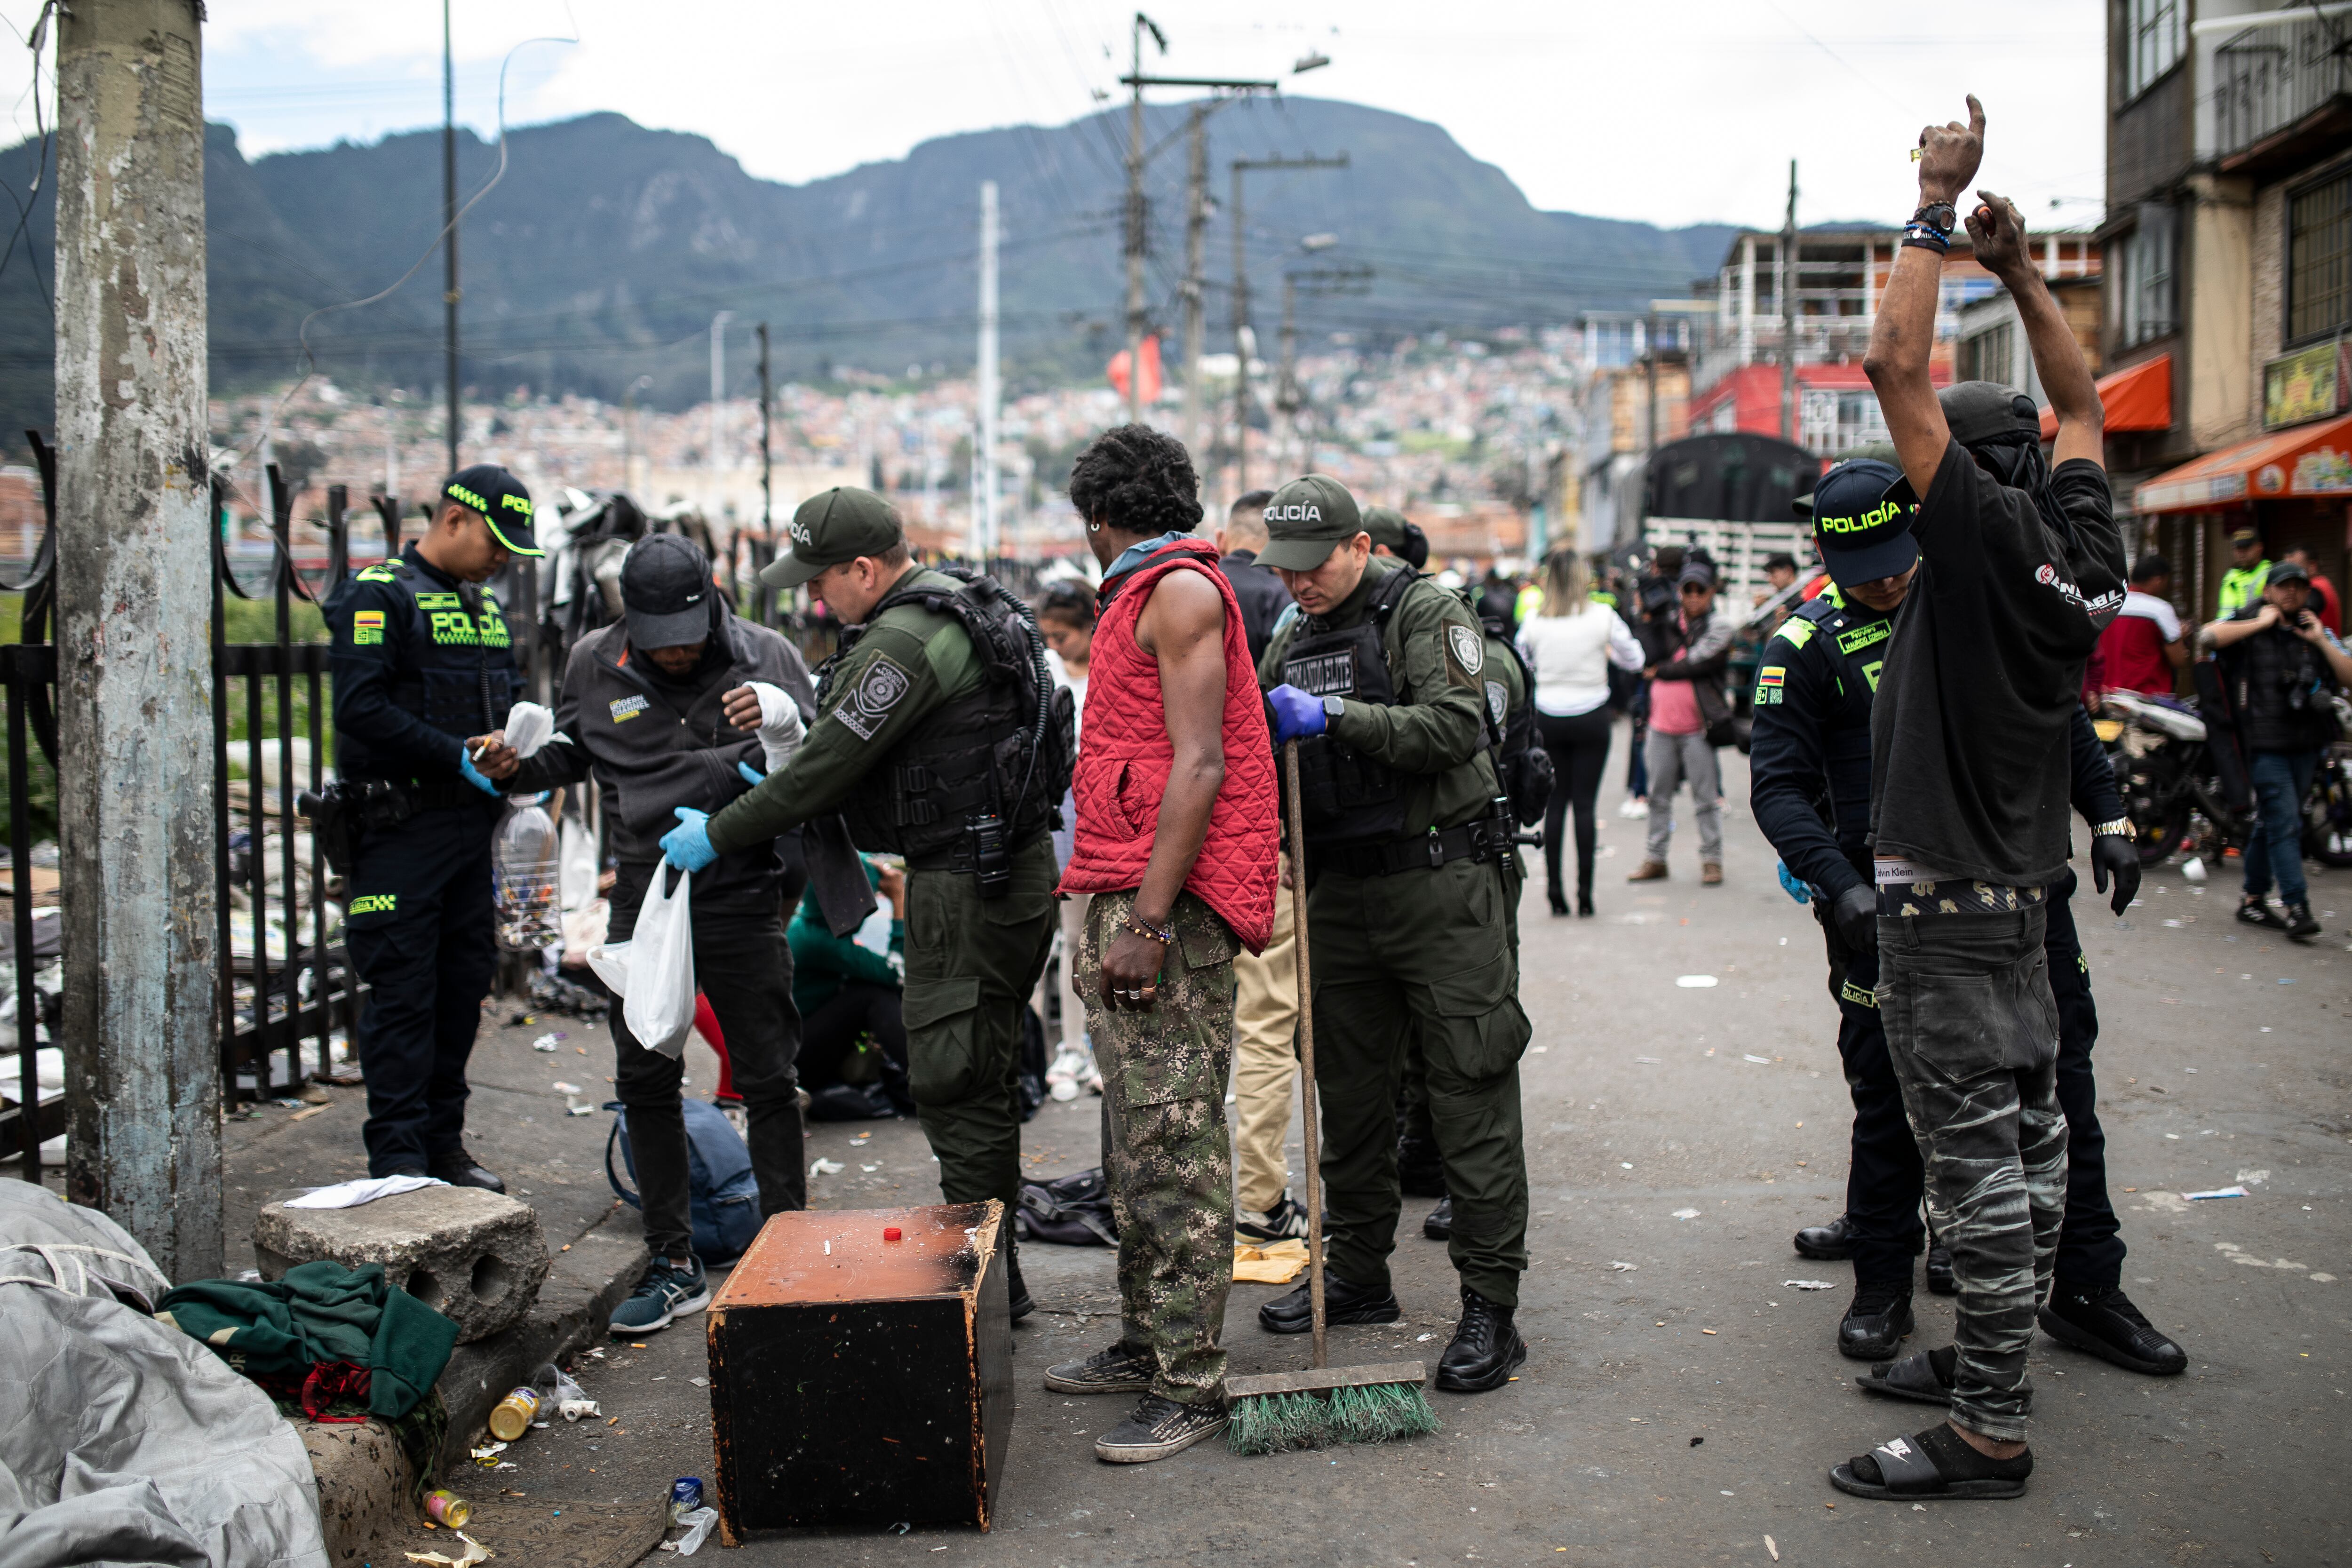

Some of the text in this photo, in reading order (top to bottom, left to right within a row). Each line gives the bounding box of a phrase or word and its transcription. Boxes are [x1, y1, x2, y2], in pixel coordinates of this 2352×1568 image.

[501, 494, 532, 516] POL
[1822, 501, 1901, 533] POLICÍA
[791, 522, 812, 547] CÍA
[1324, 655, 1351, 692] ELITE
[1757, 690, 1765, 701] B+
[1891, 867, 1913, 876] Klein
[1887, 1437, 1912, 1456] NIKE
